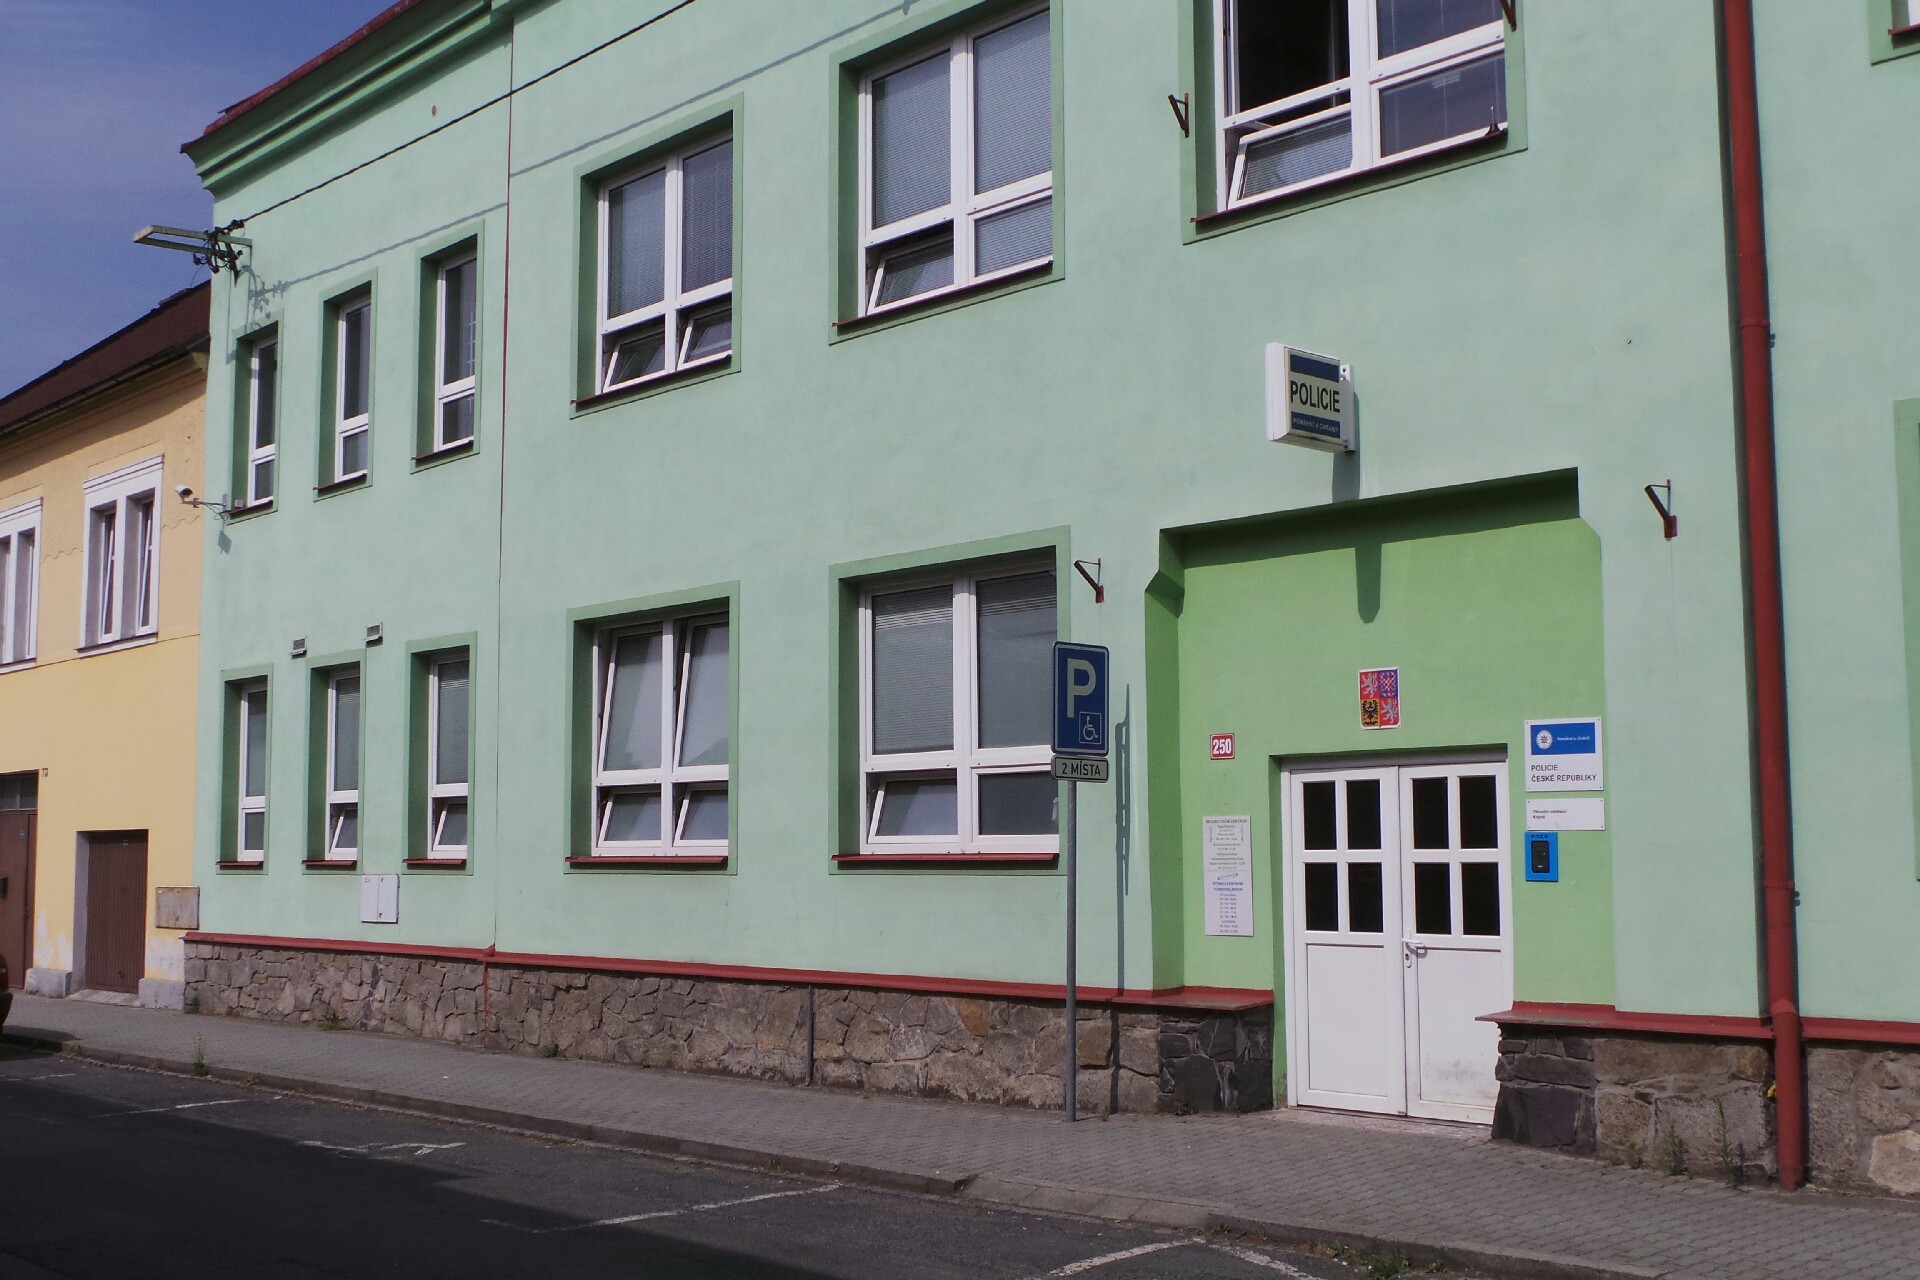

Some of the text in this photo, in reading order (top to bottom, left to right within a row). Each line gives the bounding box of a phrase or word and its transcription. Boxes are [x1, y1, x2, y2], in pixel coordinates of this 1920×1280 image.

[1289, 380, 1341, 413] POLICIE
[1066, 658, 1097, 719] P
[1212, 739, 1232, 755] 250
[1062, 760, 1101, 776] 2 MÍSTA
[1531, 764, 1559, 772] POLICIE
[1531, 773, 1597, 783] ČESKÉ REPUBLIKY
